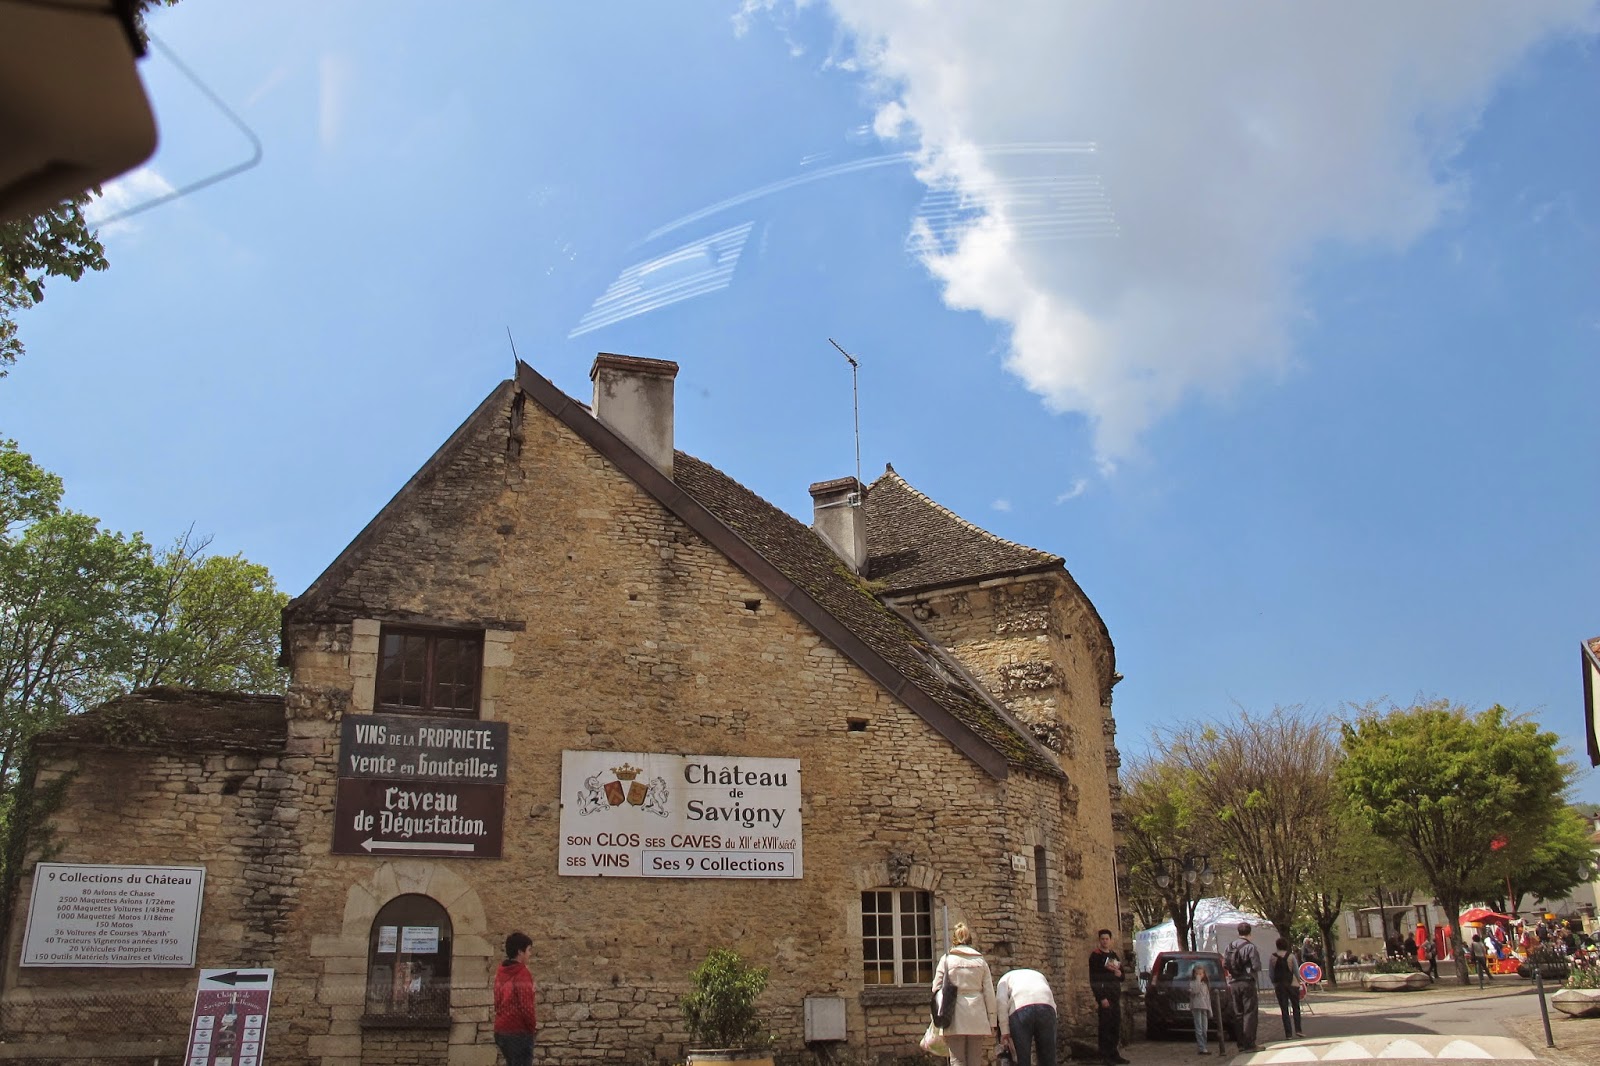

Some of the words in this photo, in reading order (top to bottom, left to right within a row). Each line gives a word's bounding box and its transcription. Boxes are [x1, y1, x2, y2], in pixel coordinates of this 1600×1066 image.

[356, 724, 387, 745] VINS
[390, 734, 401, 746] DE
[403, 734, 414, 746] LA
[401, 763, 415, 776] en
[684, 763, 788, 787] Château
[385, 787, 458, 812] Caveau
[729, 788, 744, 798] de
[354, 810, 374, 832] de
[686, 800, 786, 828] Savigny
[566, 836, 592, 846] SON
[596, 832, 640, 848] CLOS
[645, 838, 666, 848] SES
[670, 834, 722, 849] CAVES
[725, 838, 736, 849] du
[754, 838, 761, 850] et
[566, 856, 586, 866] SES
[592, 854, 630, 868] VINS
[652, 856, 680, 870] Ses
[686, 858, 695, 871] 9
[700, 857, 785, 872] Collections
[48, 872, 56, 882] 9
[60, 872, 123, 884] Collections
[126, 874, 142, 884] du
[145, 874, 192, 885] Château
[80, 896, 118, 904] Maquettes
[72, 904, 112, 912] Maquettes
[94, 938, 131, 946] Vignerons
[118, 946, 152, 954] Pompiers
